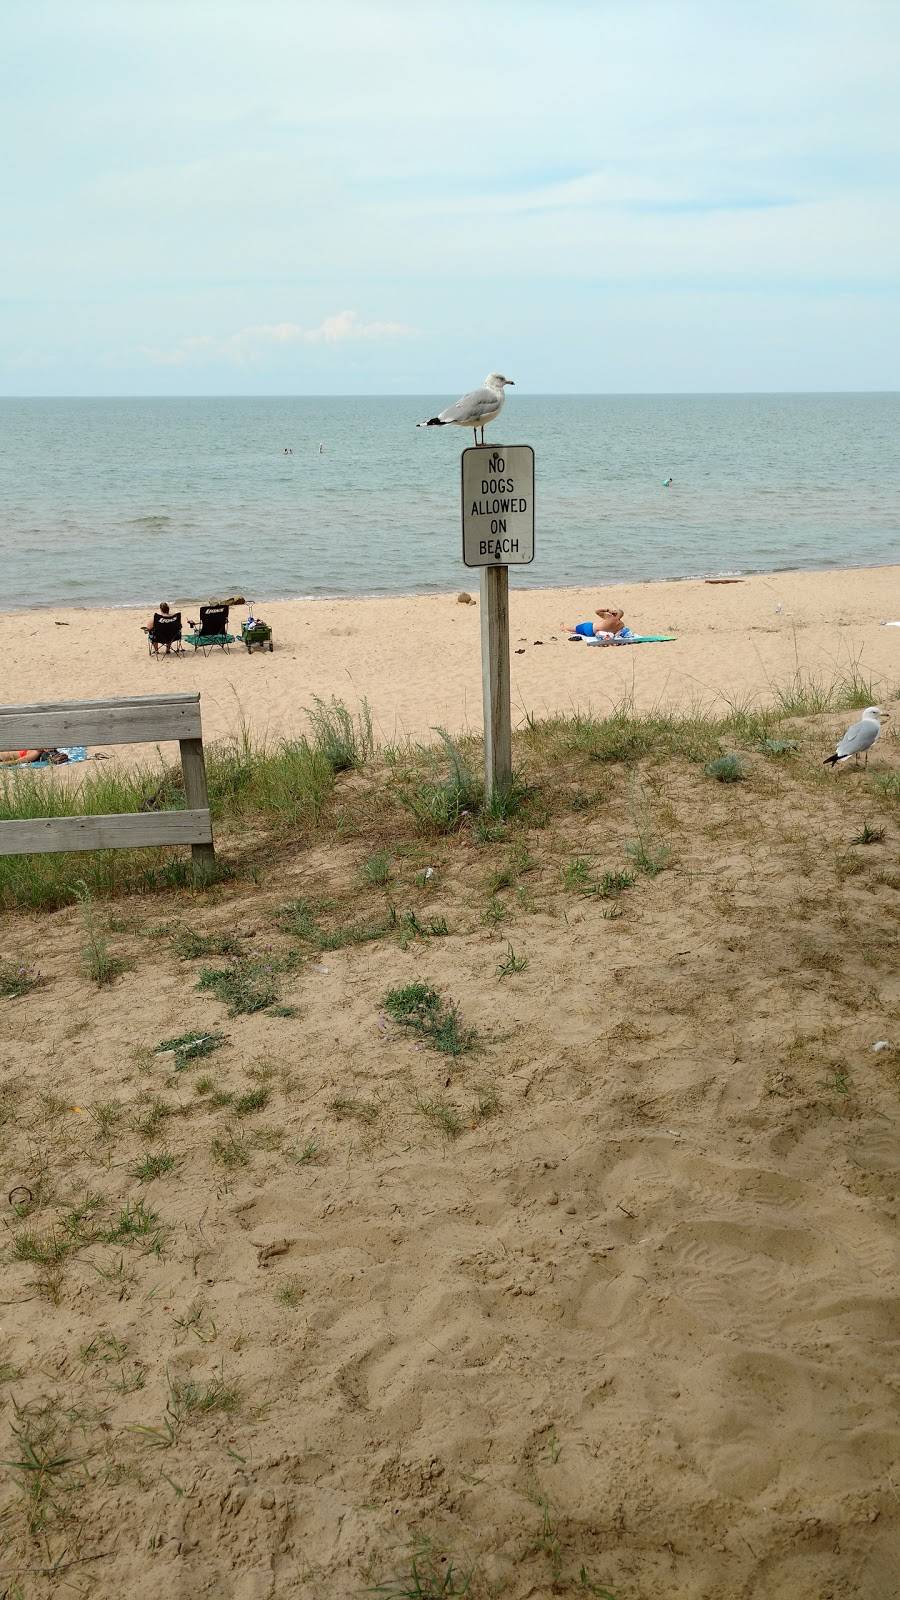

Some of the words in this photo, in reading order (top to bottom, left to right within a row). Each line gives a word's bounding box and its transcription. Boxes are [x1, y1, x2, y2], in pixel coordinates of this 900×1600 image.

[489, 458, 505, 473] NO
[481, 478, 514, 494] DOGS
[471, 498, 527, 516] ALLOWED
[490, 519, 507, 534] ON
[479, 539, 519, 555] BEACH
